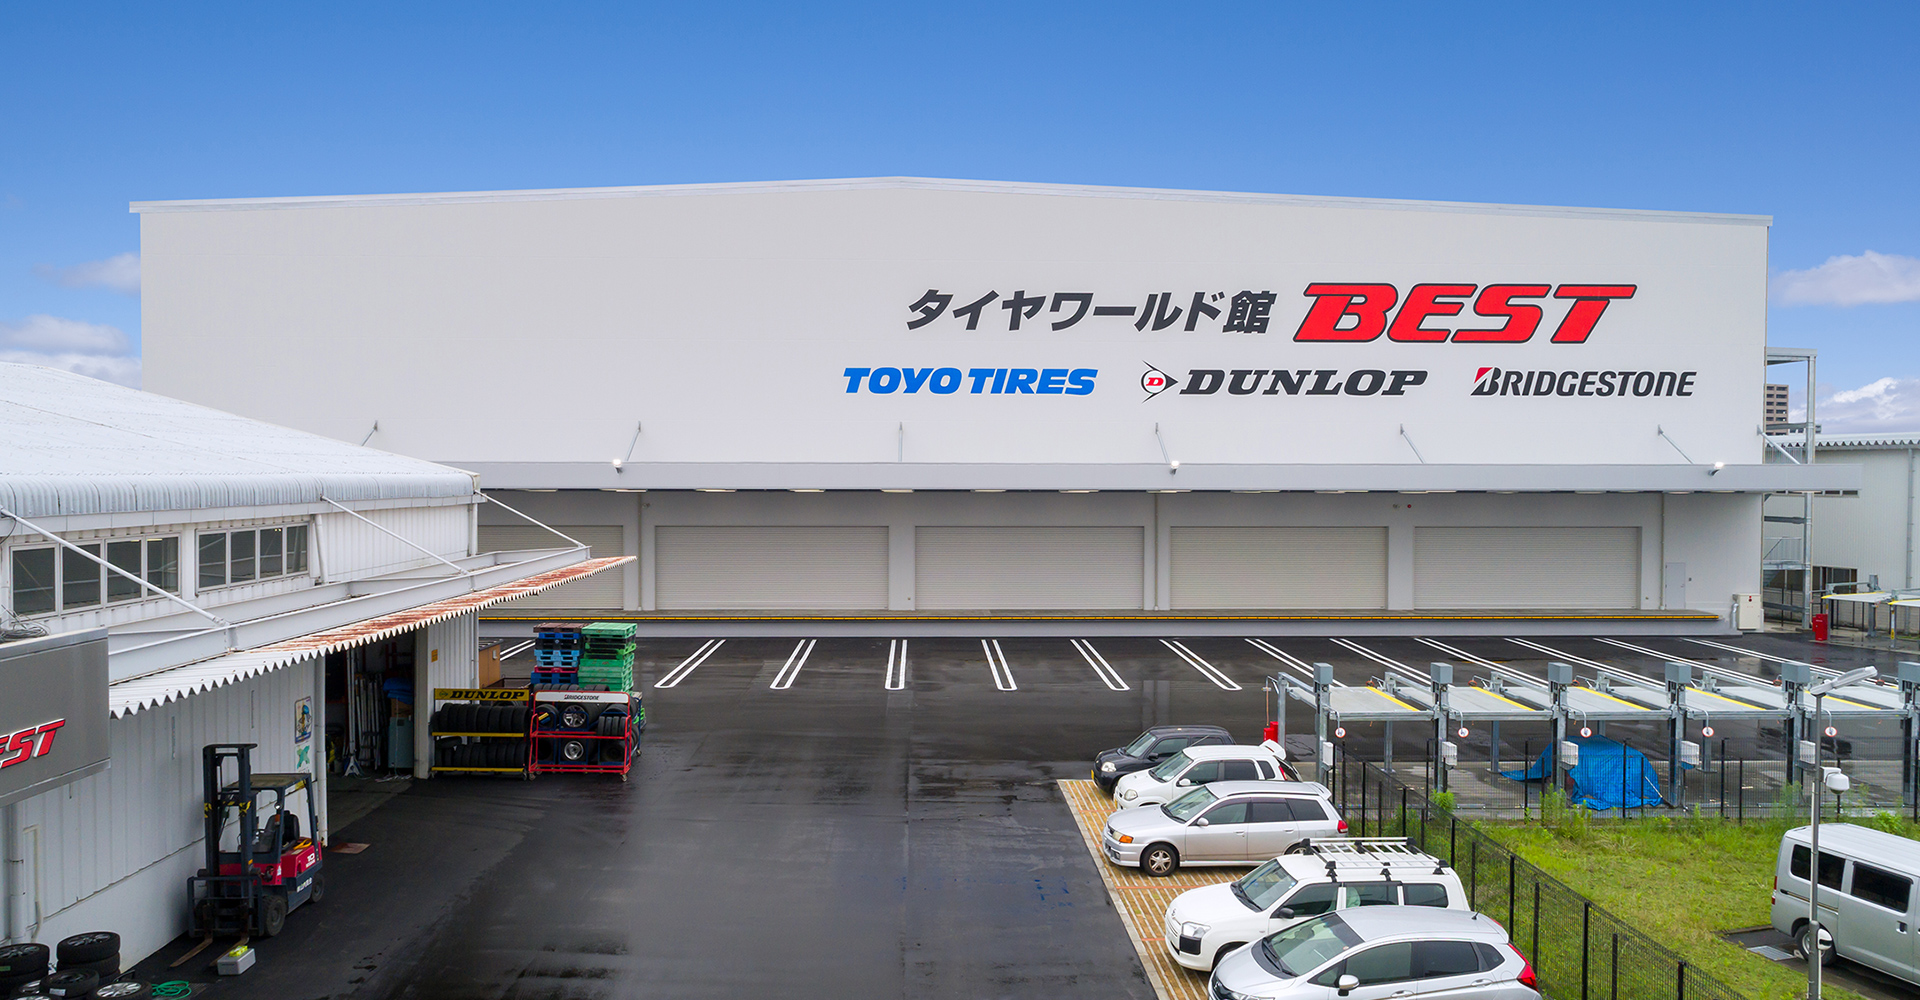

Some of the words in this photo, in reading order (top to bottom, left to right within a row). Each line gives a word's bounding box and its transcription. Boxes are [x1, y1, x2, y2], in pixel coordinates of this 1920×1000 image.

[906, 288, 1278, 334] タイヤワールド館
[1292, 282, 1638, 345] BEST
[843, 366, 963, 395] TOYO
[967, 367, 1099, 396] TIRES
[1178, 369, 1429, 397] DUNLOP
[1470, 366, 1698, 397] BRIDGESTONE
[450, 690, 525, 699] DUNLOP
